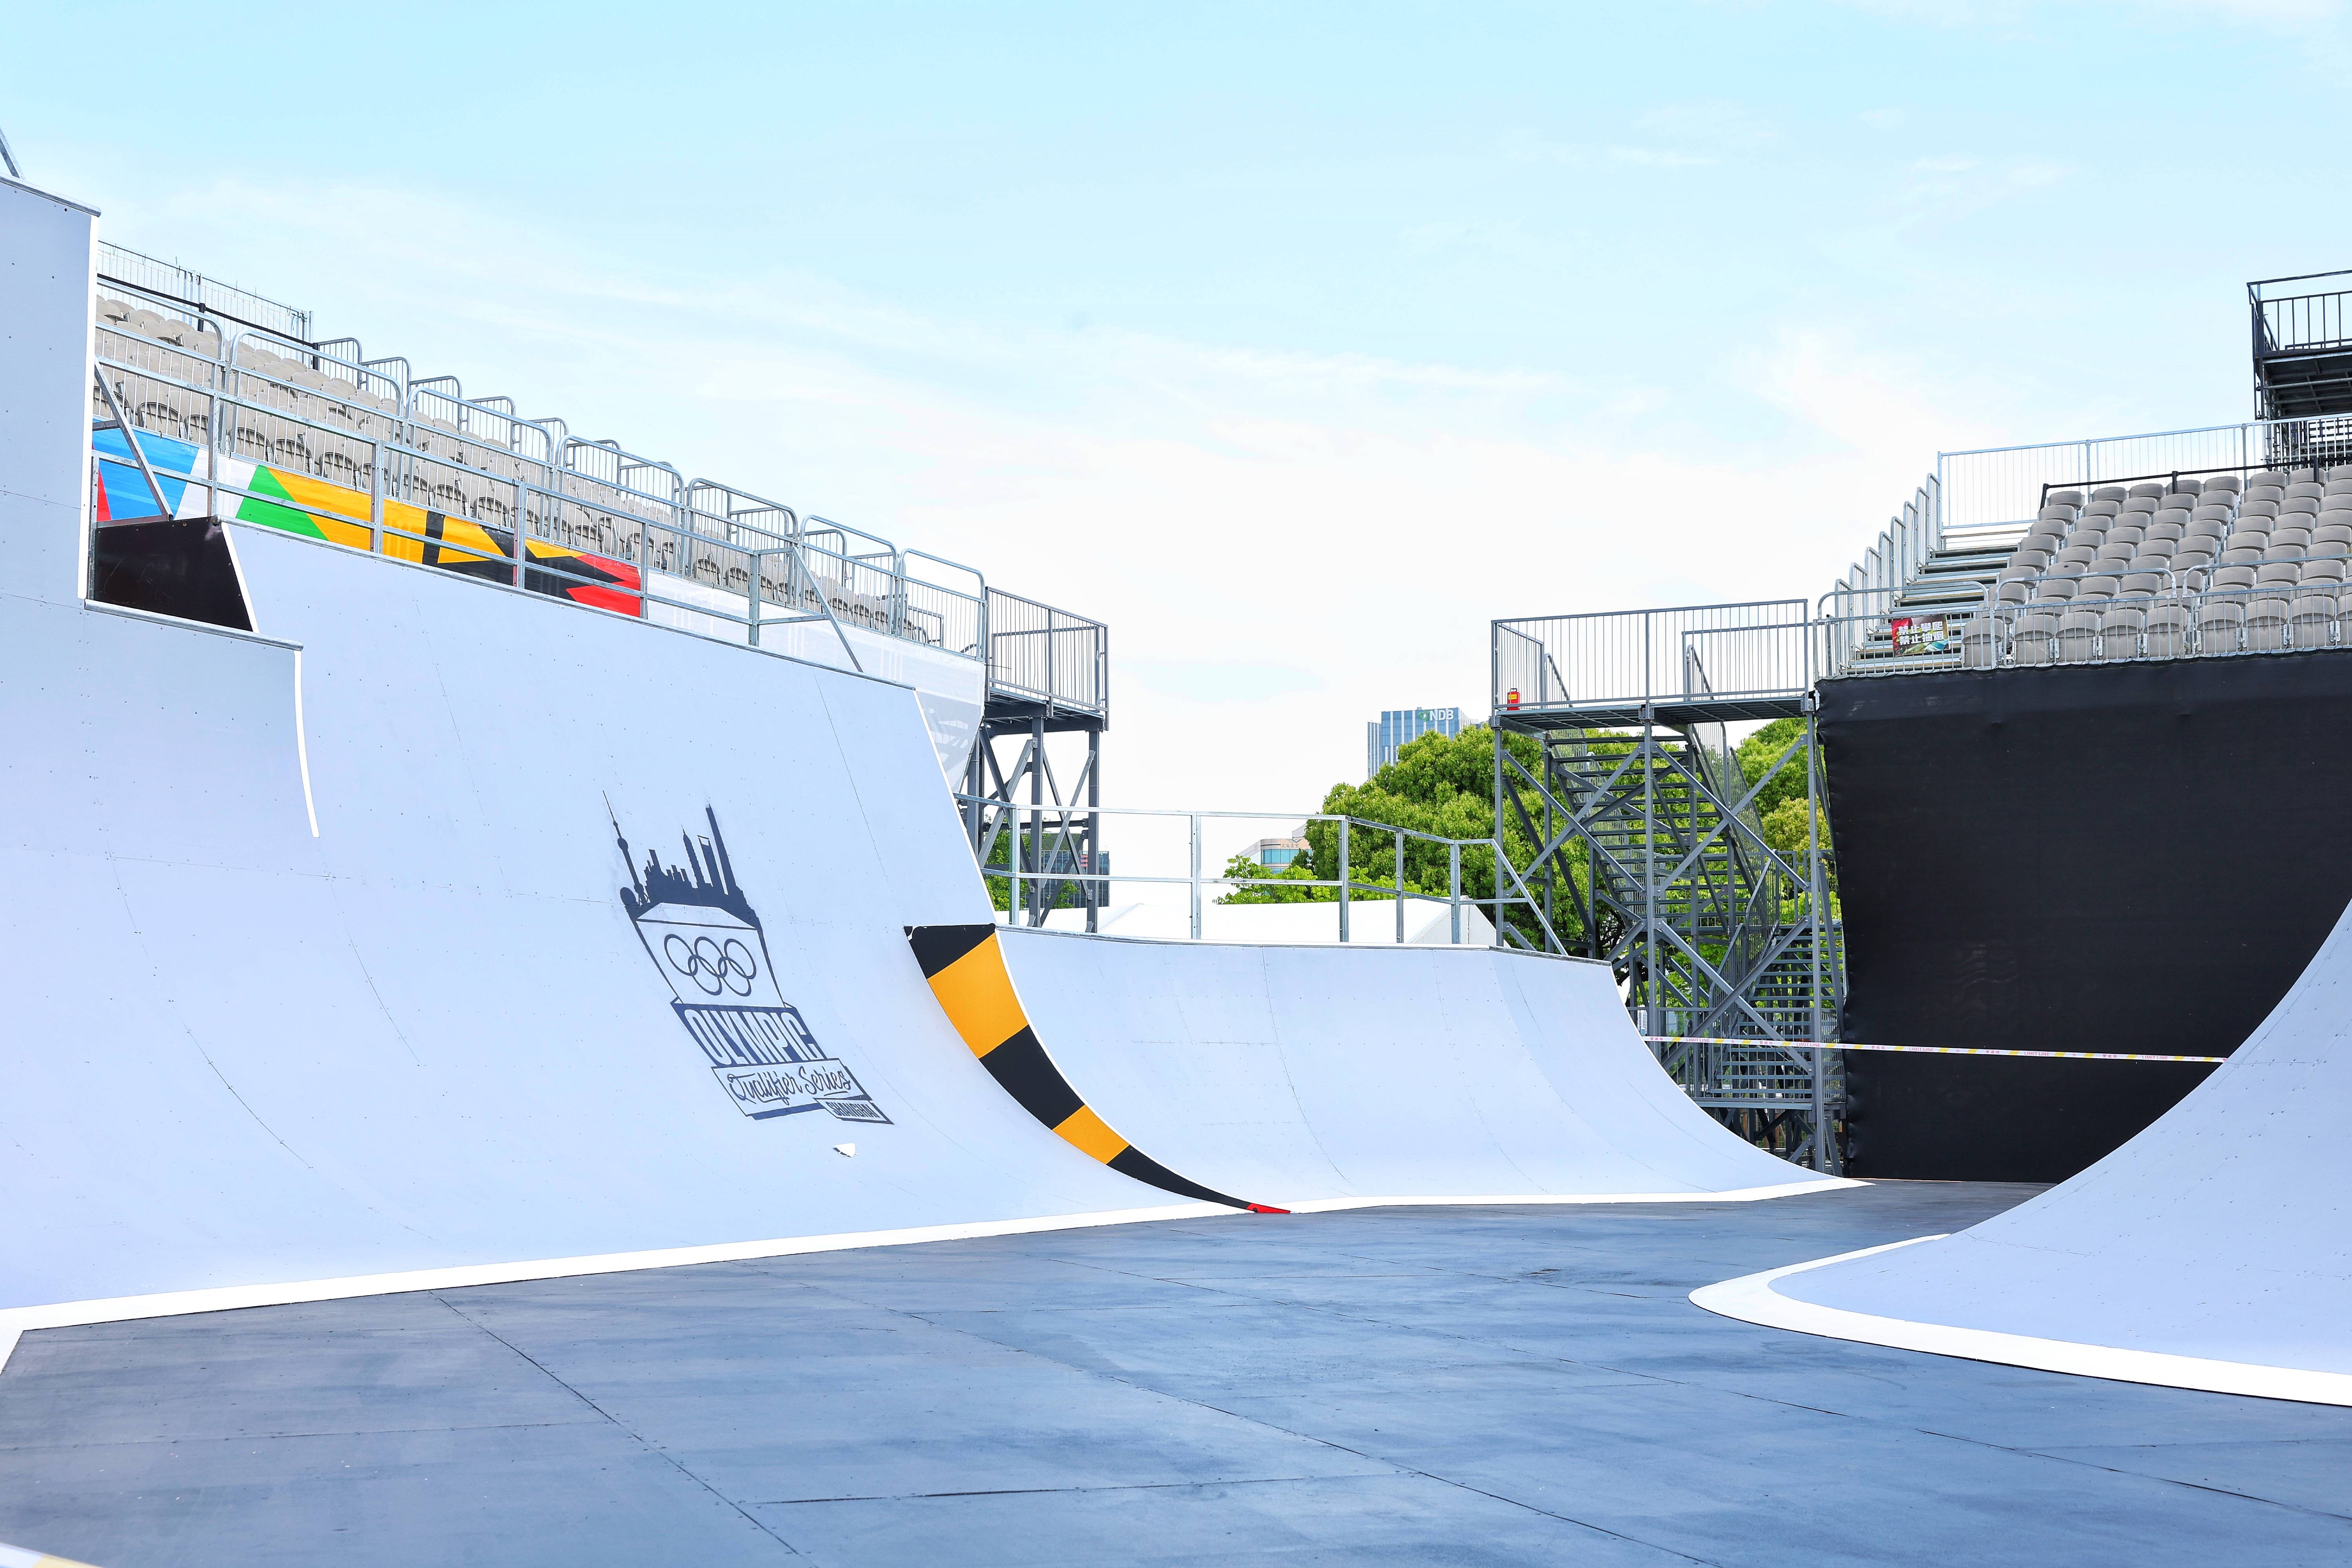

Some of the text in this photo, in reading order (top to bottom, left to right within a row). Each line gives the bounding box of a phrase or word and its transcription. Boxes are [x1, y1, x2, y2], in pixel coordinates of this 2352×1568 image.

[1898, 621, 1943, 635] 禁止攀爬
[1899, 631, 1944, 645] 禁止抽烟
[1430, 710, 1454, 721] NDB
[684, 1009, 824, 1065] OLYMPIC
[727, 1066, 851, 1105] Qualifier Series
[826, 1102, 881, 1118] SHANGHAI
